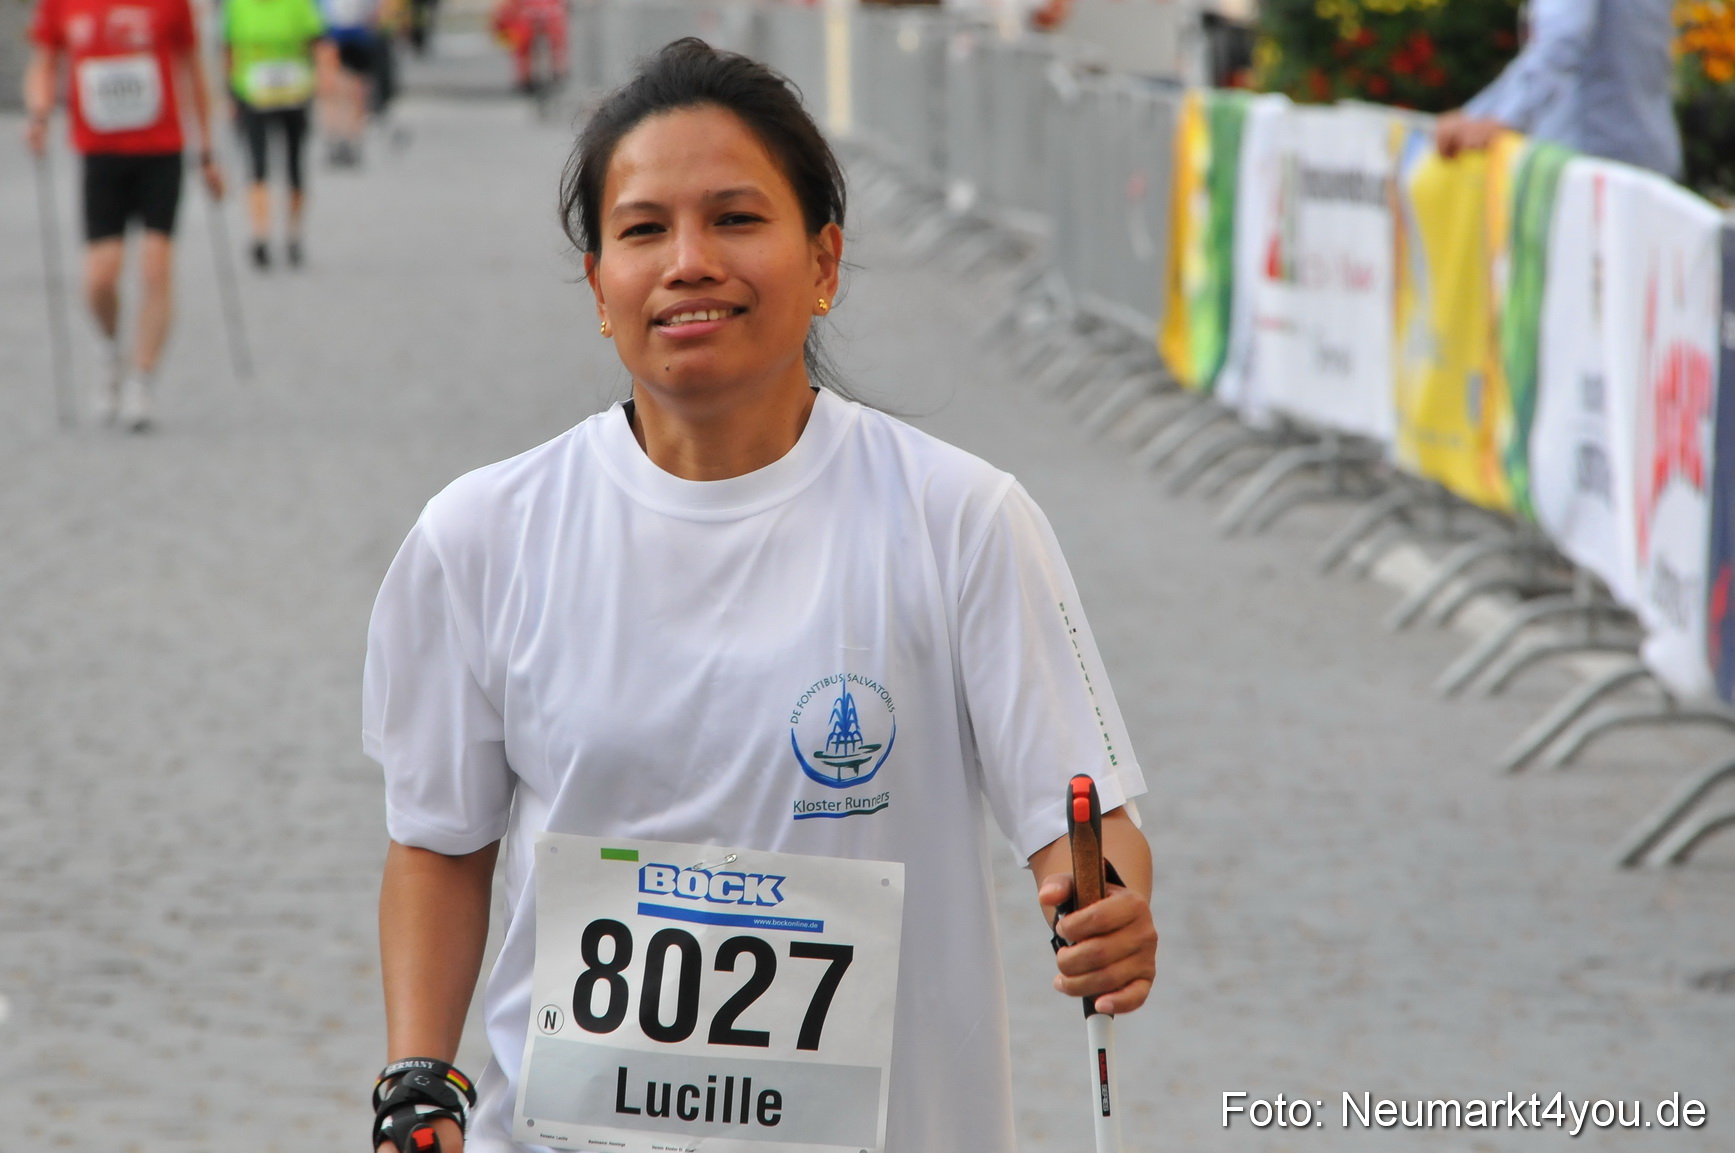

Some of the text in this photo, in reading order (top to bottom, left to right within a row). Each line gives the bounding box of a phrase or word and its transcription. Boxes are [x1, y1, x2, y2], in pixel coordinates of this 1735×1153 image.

[790, 673, 895, 725] DE FONTIBUS SALVATORIS
[793, 791, 890, 814] Kloster Runners
[639, 863, 786, 907] BOCK
[753, 917, 819, 930] www.bockonline.de
[572, 918, 854, 1051] 8027
[543, 1009, 557, 1031] N
[385, 1061, 435, 1074] GERMANY
[615, 1066, 783, 1128] Lucille
